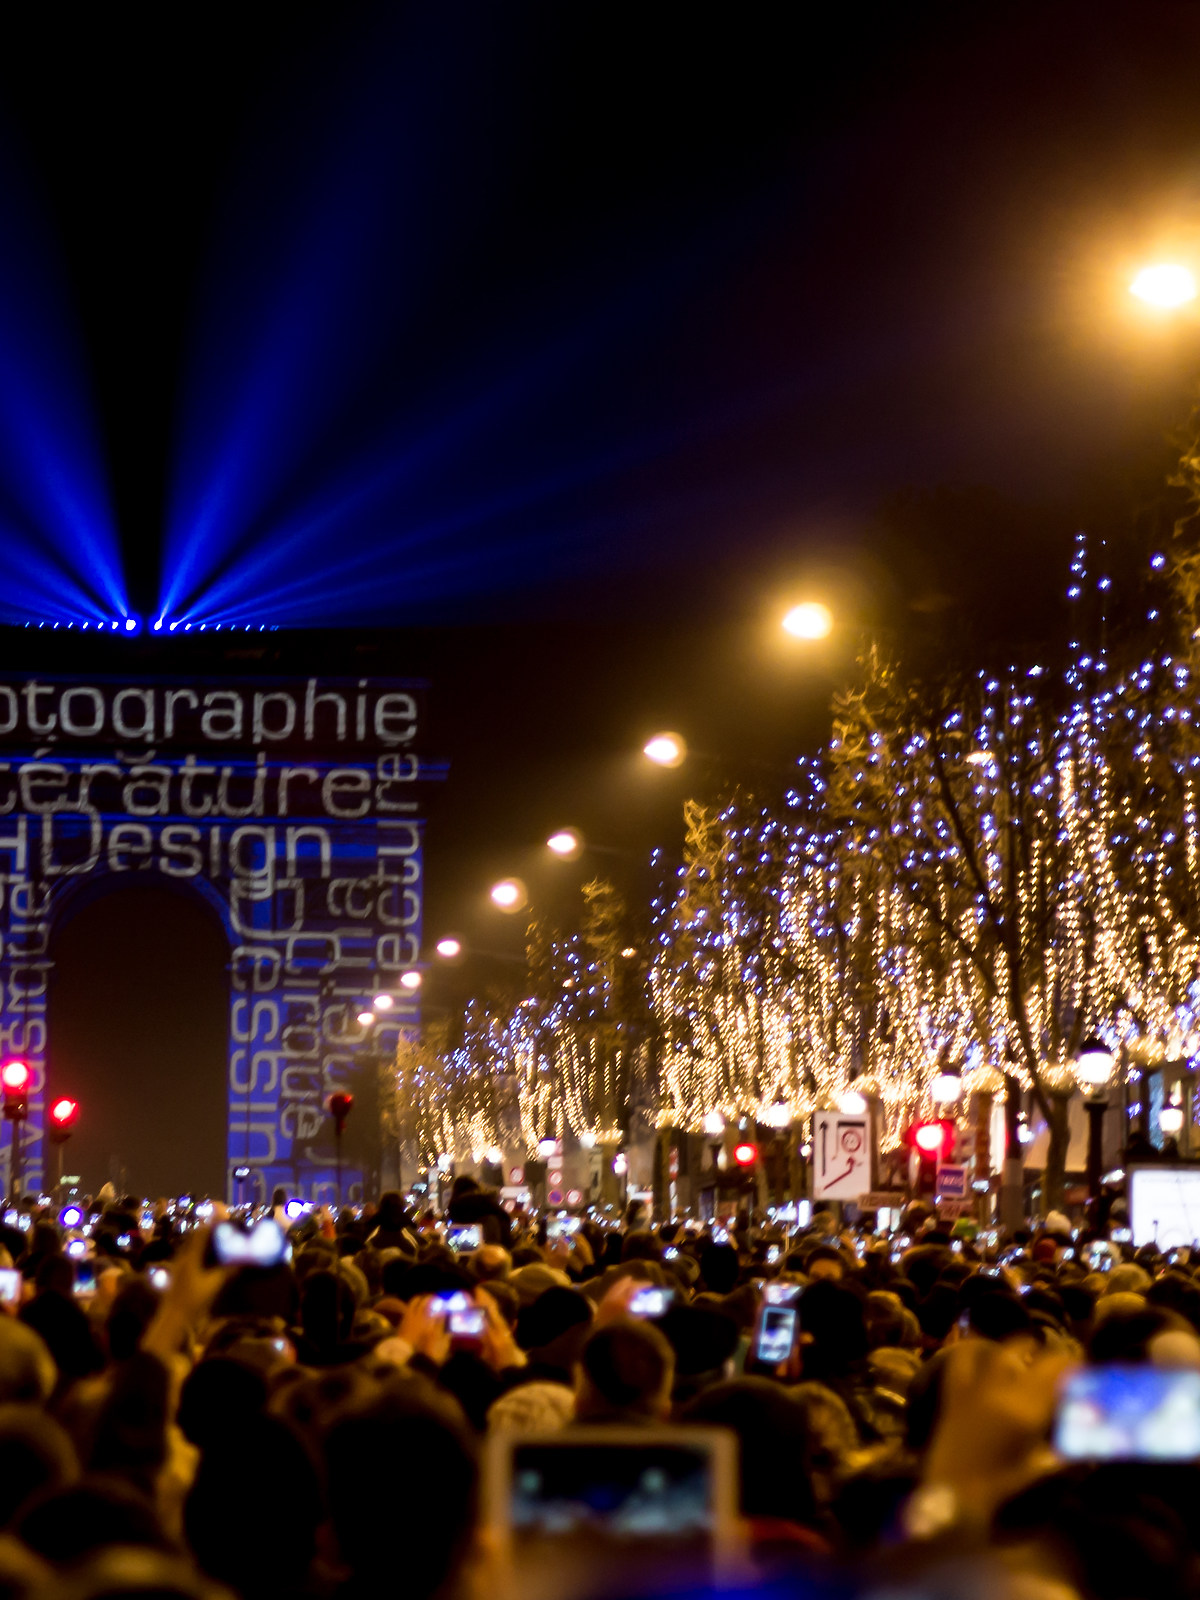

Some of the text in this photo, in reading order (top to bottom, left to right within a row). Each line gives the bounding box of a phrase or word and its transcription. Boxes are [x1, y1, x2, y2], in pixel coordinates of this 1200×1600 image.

[42, 803, 331, 899] Design
[367, 752, 420, 1058] hitecture
[230, 877, 304, 1165] Dessin
[274, 932, 341, 1139] Cirque
